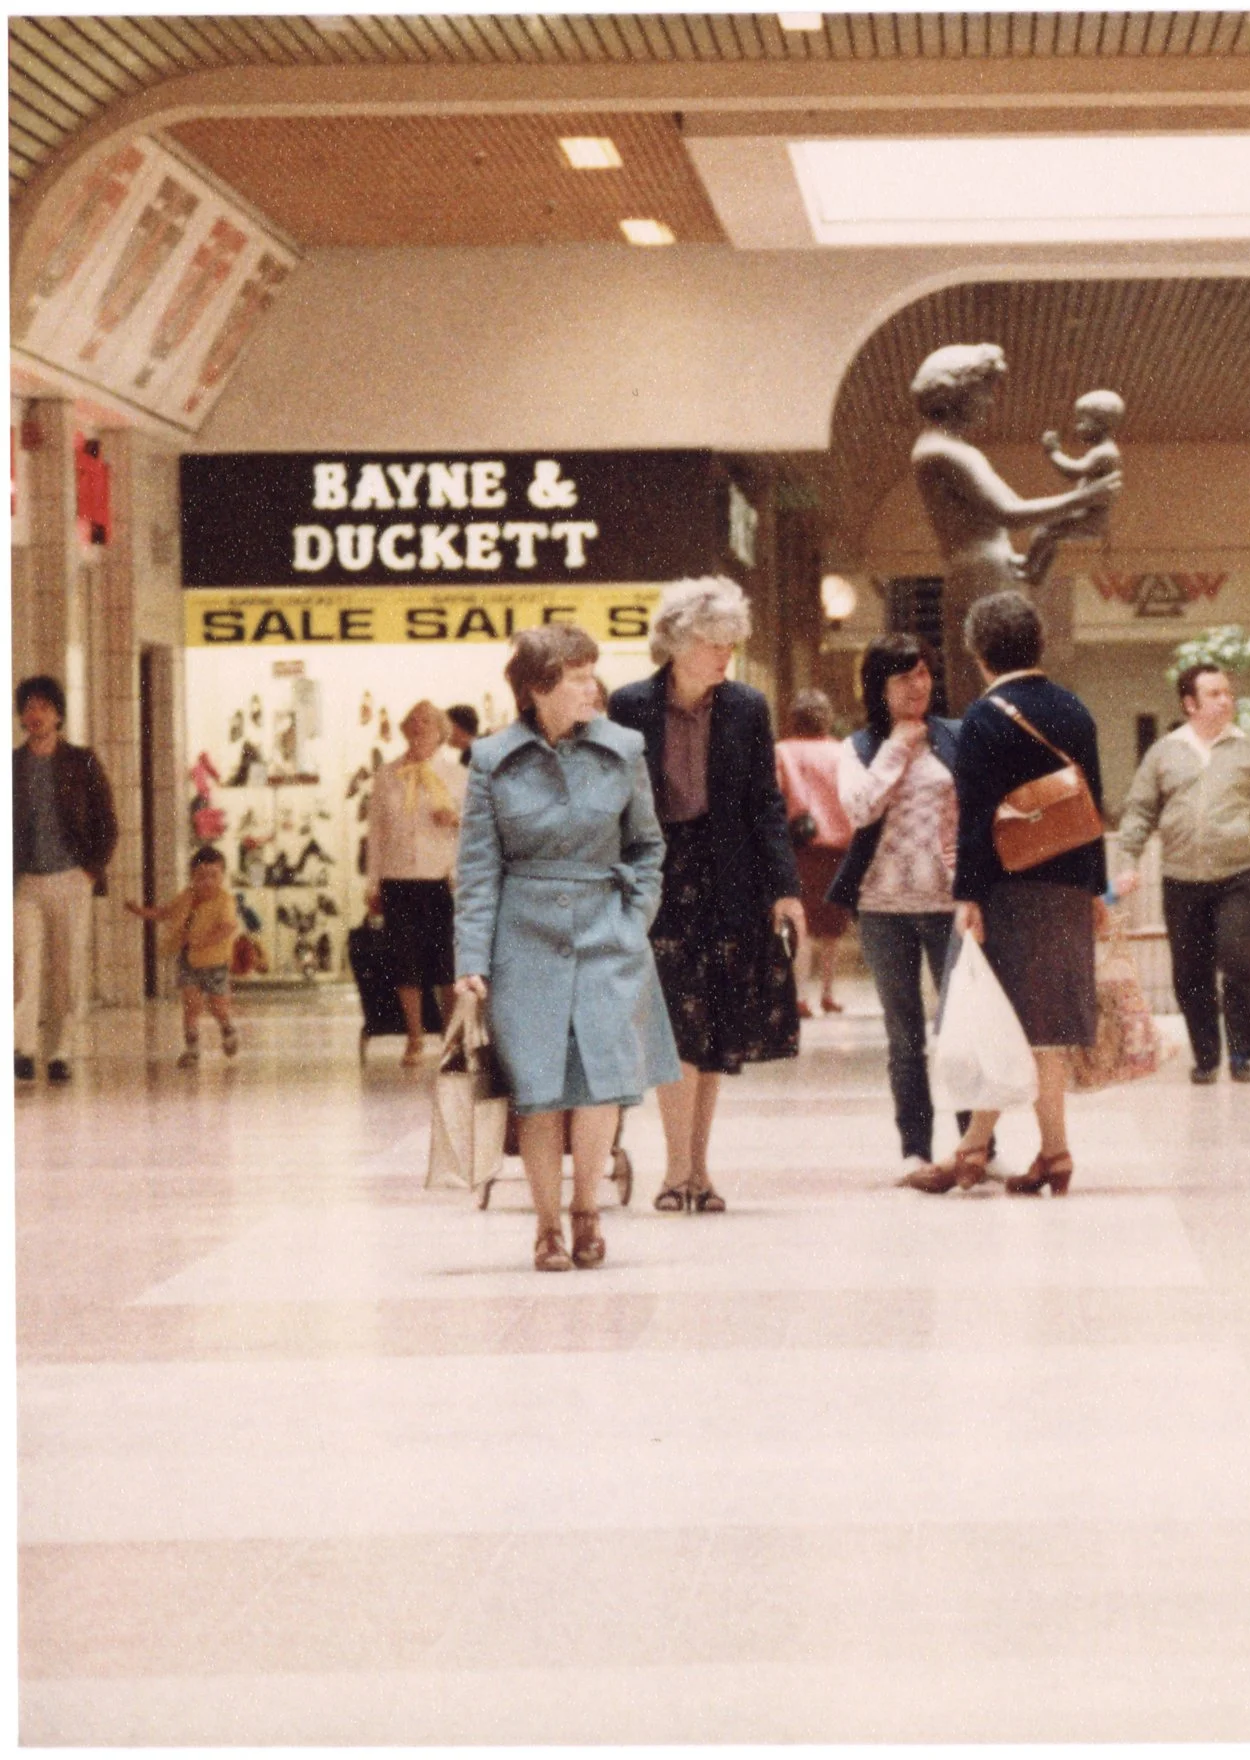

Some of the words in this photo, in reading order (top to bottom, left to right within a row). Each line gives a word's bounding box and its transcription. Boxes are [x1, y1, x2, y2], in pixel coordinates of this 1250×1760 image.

[312, 461, 506, 510] BAYNE
[527, 459, 578, 509] &
[292, 521, 598, 571] DUCKETT
[203, 608, 375, 642] SALE
